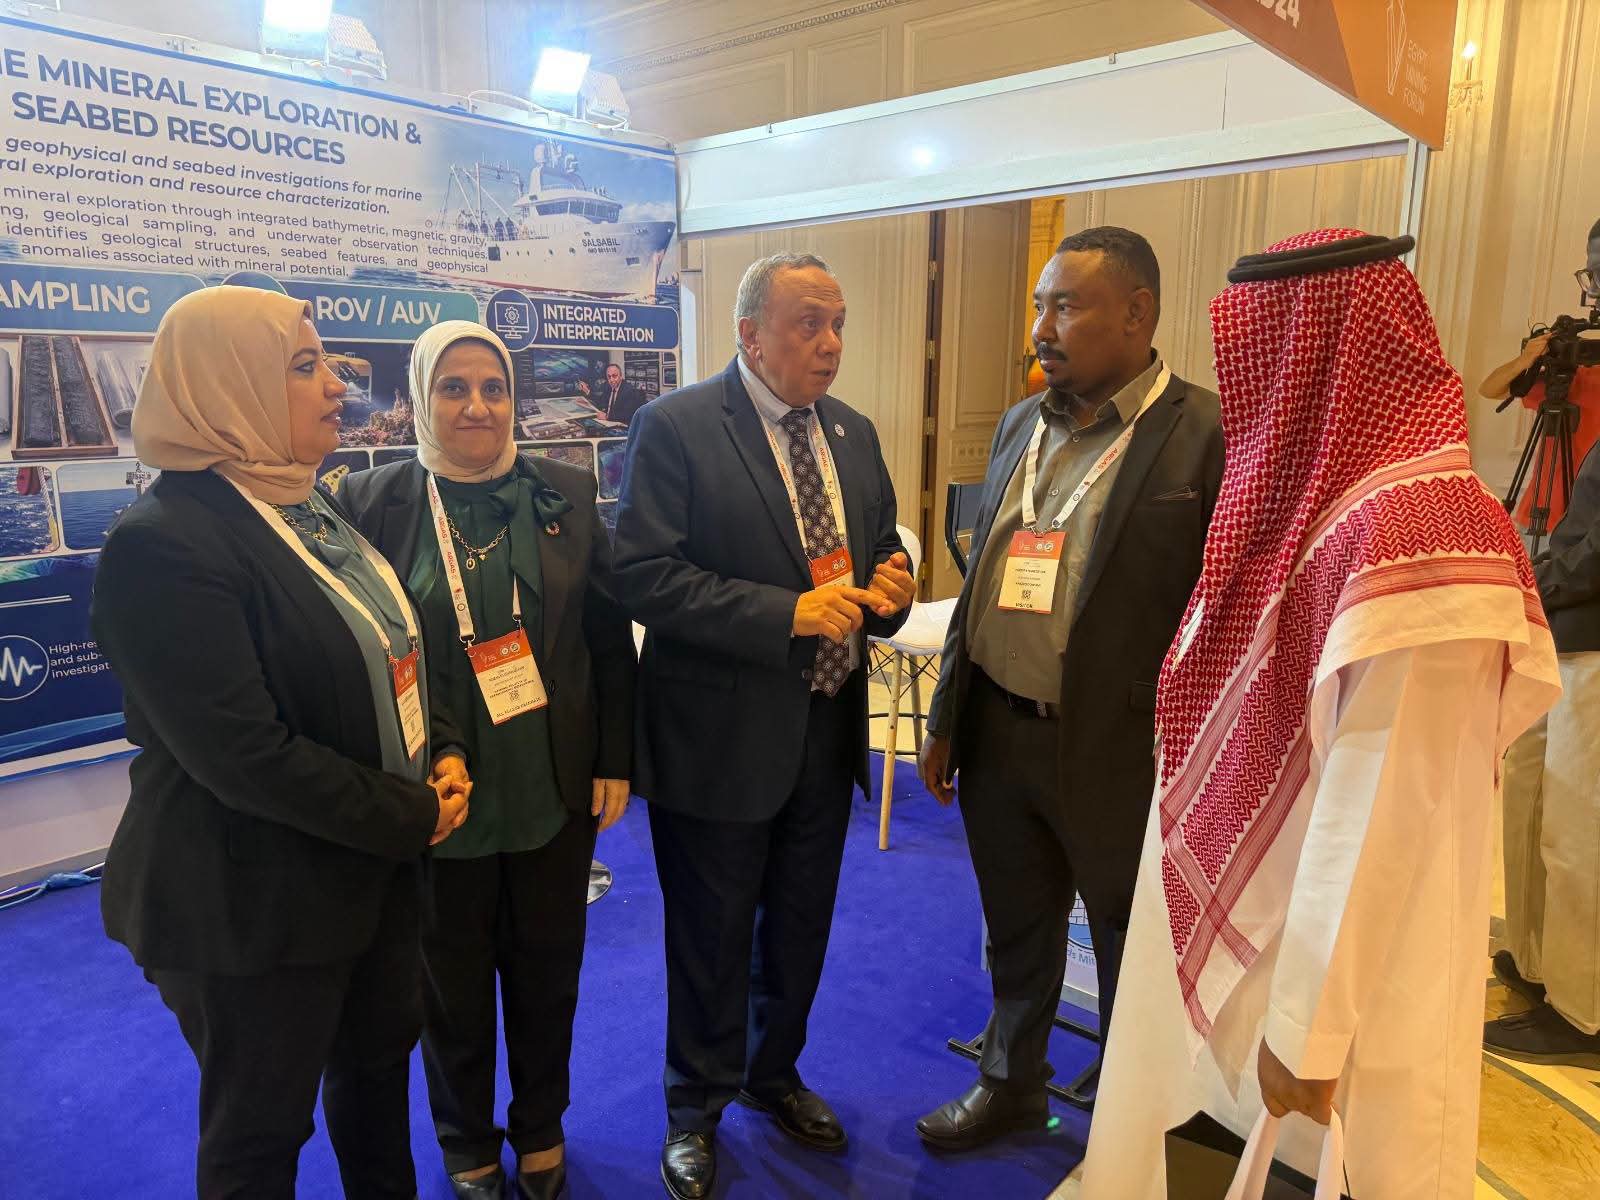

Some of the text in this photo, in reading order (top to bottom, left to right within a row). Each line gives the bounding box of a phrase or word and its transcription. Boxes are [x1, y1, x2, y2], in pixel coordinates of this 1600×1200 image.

[1257, 0, 1299, 28] 24
[0, 48, 422, 145] E MINERAL EXPLORATION &
[13, 91, 346, 165] SEABED RESOURCES
[5, 137, 423, 202] geophysical and seabed investigations for marine
[32, 161, 144, 186] exploration
[149, 174, 184, 191] and
[189, 180, 261, 199] resource
[265, 188, 391, 215] characterization.
[3, 186, 487, 248] mineral exploration through integrated bathymetric, magnetic, gravity,
[43, 209, 129, 227] geological
[142, 219, 217, 237] sampling,
[228, 226, 255, 238] and
[267, 230, 342, 246] underwater
[352, 238, 419, 253] observation
[6, 221, 489, 273] identifies geological structures, seabed features, and geophysical
[21, 243, 349, 277] anomalies associated with mineral potential.
[582, 237, 620, 247] SALSABIL
[315, 295, 441, 326] ROV / AUV
[543, 303, 627, 324] INTEGRATED
[543, 323, 654, 342] INTERPRETATION
[50, 651, 102, 667] and sub-
